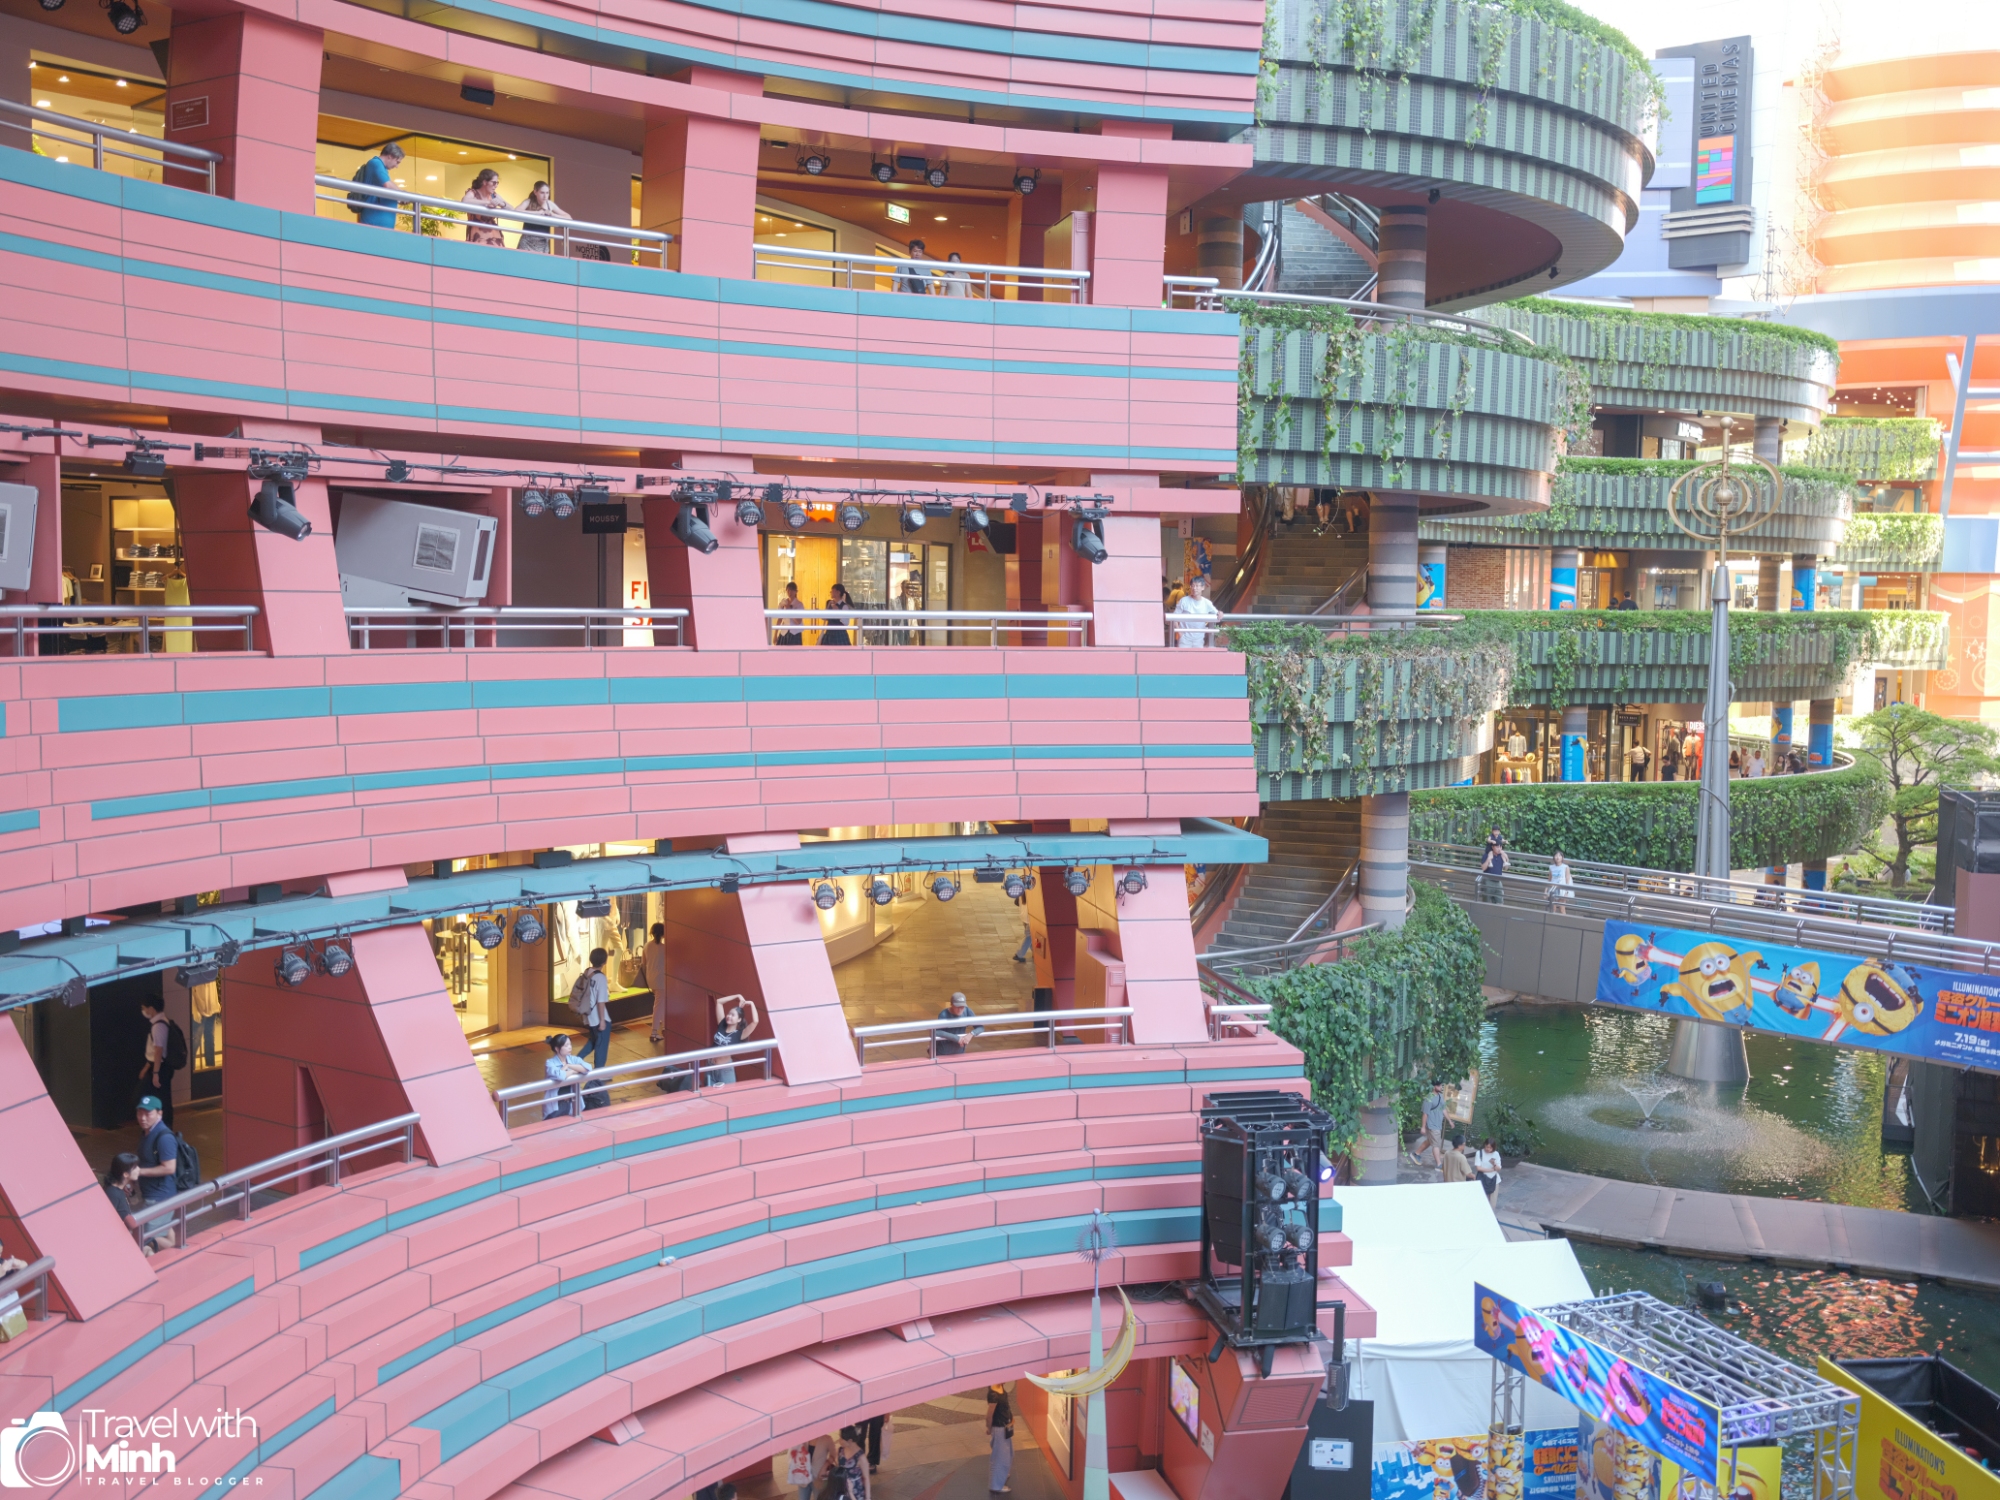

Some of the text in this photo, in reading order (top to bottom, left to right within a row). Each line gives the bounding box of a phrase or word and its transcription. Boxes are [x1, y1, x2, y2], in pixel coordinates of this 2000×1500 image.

[1700, 63, 1719, 137] UNITED
[1719, 44, 1740, 135] CINEMAS
[575, 245, 599, 255] NORTH
[589, 515, 620, 523] MOUSSY
[631, 581, 647, 600] FI
[1894, 1427, 1946, 1476] ILLUMINATION'S
